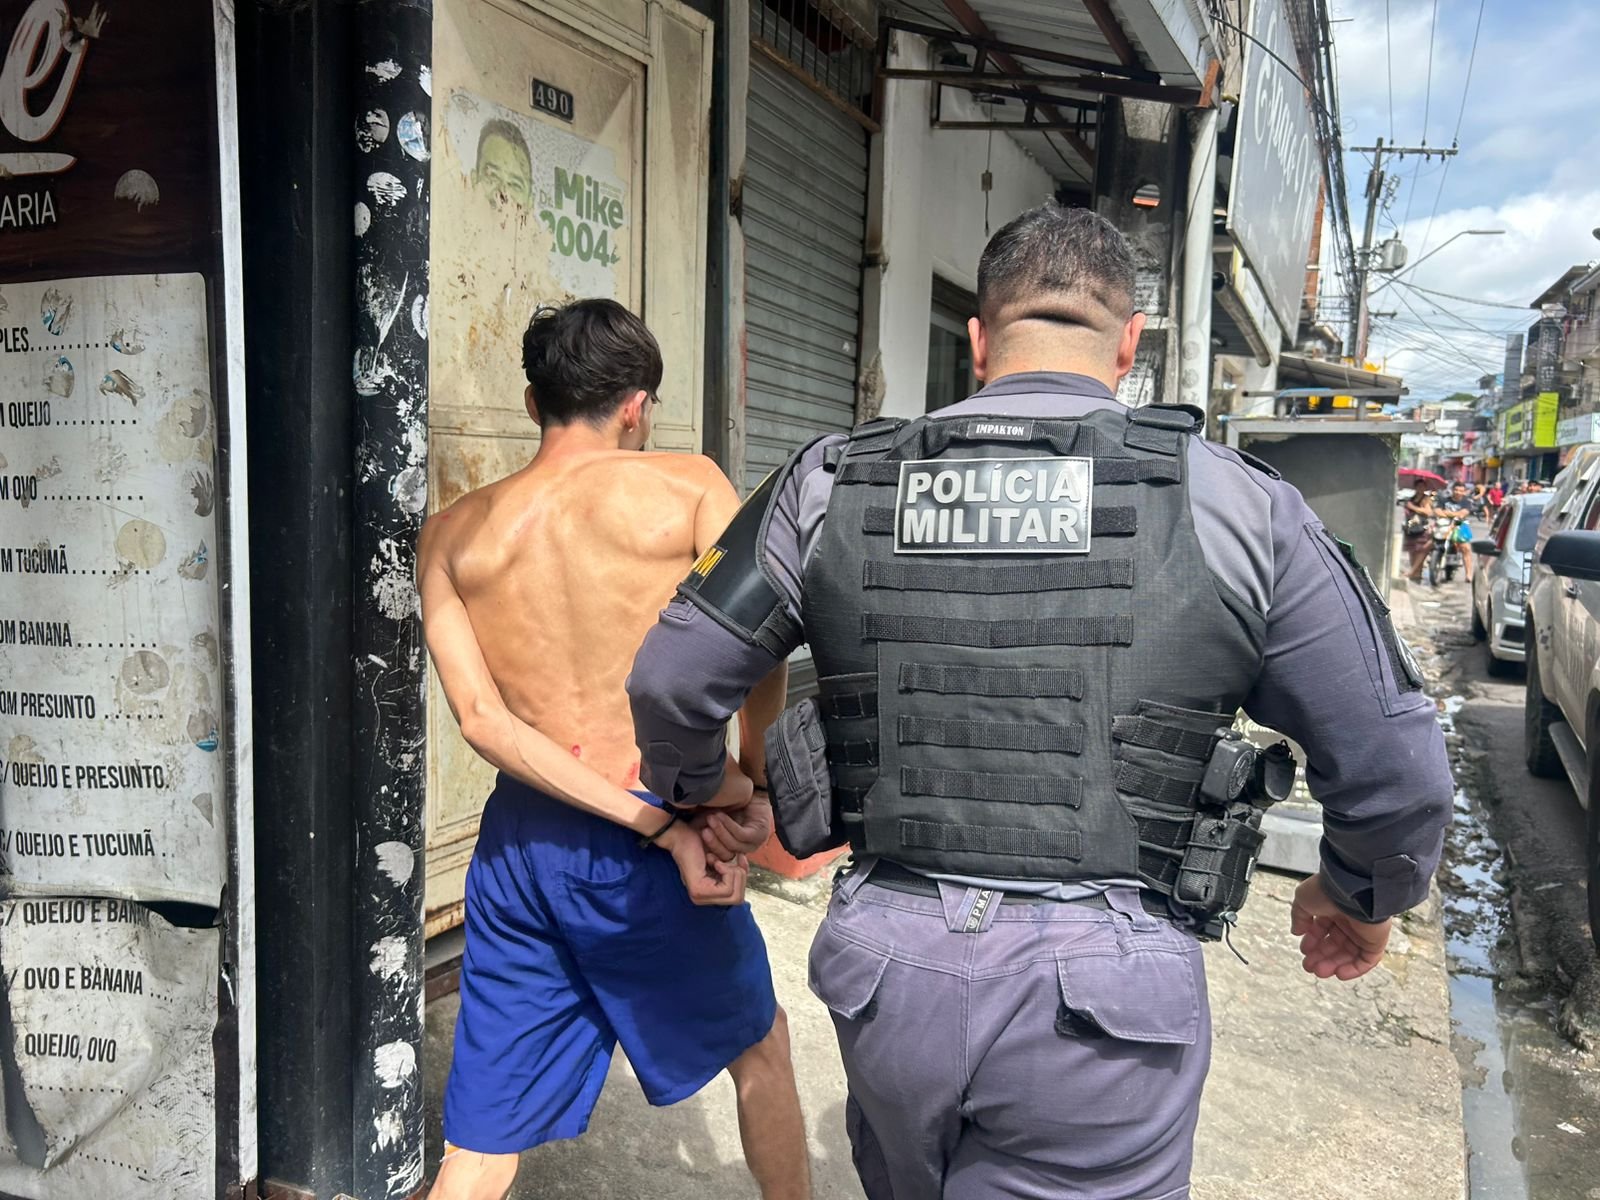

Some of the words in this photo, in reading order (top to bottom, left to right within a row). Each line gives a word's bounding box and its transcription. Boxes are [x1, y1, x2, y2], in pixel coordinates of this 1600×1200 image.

[535, 85, 569, 112] 490
[0, 190, 57, 228] ARIA
[554, 166, 623, 230] Mike
[9, 401, 51, 429] QUEIJO
[975, 424, 1025, 436] IMPAKTON
[13, 475, 37, 500] OVO
[906, 464, 1081, 504] POLÍCIA
[902, 508, 1079, 543] MILITAR
[16, 544, 69, 574] TUCUMÃ
[20, 620, 72, 647] BANANA
[0, 690, 17, 715] OM
[21, 692, 96, 719] PRESUNTO
[12, 761, 58, 788] QUEIJO
[62, 765, 72, 788] E
[16, 831, 64, 857] QUEIJO
[69, 834, 80, 857] E
[83, 829, 155, 857] TUCUMÃ
[23, 901, 85, 924] QUEIJO
[91, 900, 101, 923] E
[973, 890, 990, 917] PMA
[24, 967, 59, 990] OVO
[65, 967, 75, 989] E
[81, 967, 143, 995] BANANA
[25, 1033, 82, 1062] QUEIJO,
[87, 1037, 117, 1063] OVO
